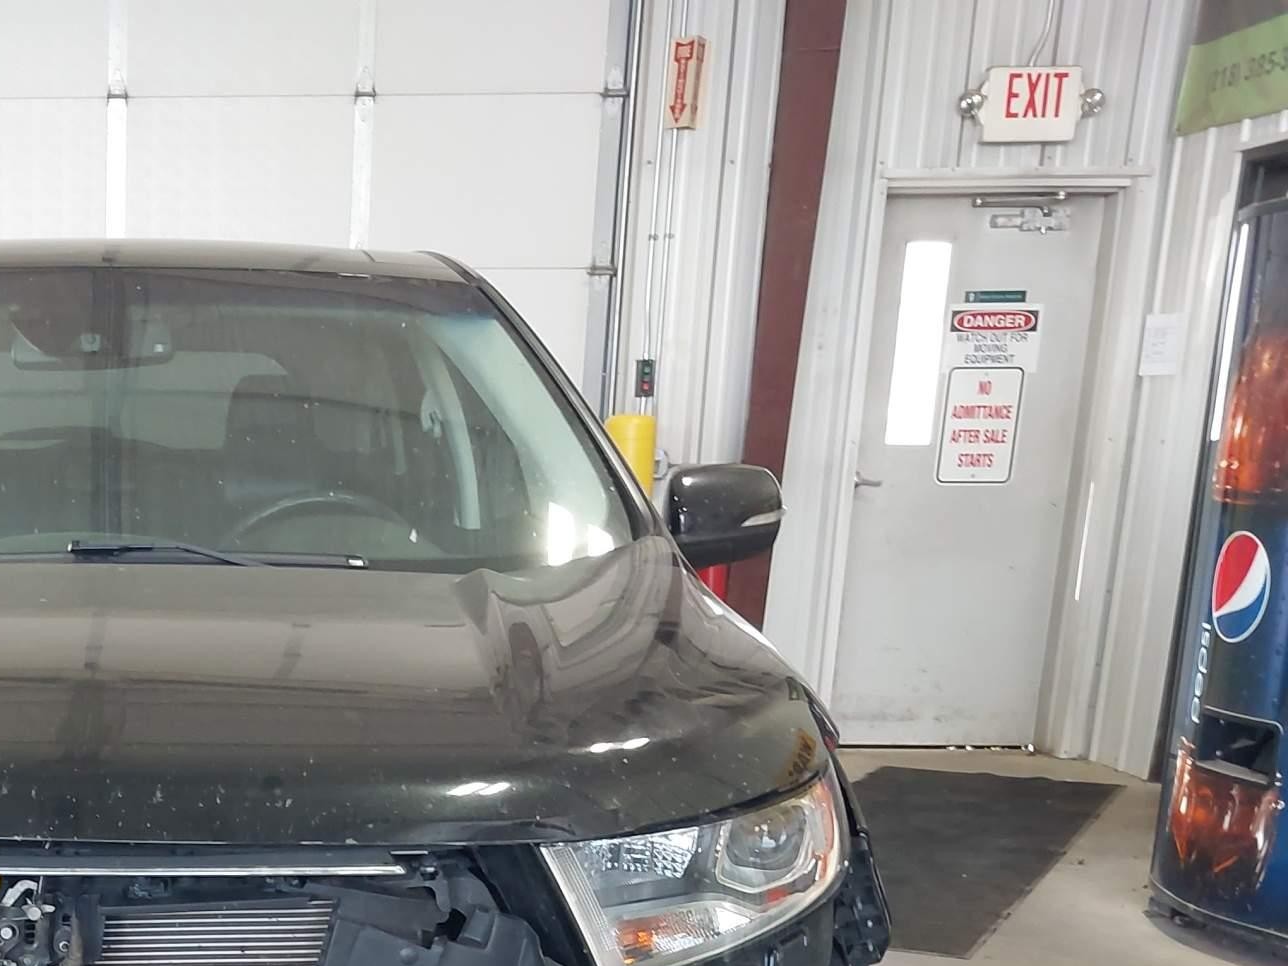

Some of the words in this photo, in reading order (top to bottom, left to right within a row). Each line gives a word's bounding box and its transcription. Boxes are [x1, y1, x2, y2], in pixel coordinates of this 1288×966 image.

[1005, 72, 1069, 118] EXIT
[962, 314, 1026, 328] DANGER
[989, 332, 1008, 342] OUT
[1010, 332, 1029, 343] FOR
[974, 343, 1008, 353] MOVING
[964, 353, 1015, 364] EQUIPMENT
[977, 381, 993, 395] NO
[951, 405, 1013, 420] ADMITTANCE
[949, 429, 980, 444] AFTER
[983, 429, 1009, 444] SALE
[957, 453, 994, 468] STARTS
